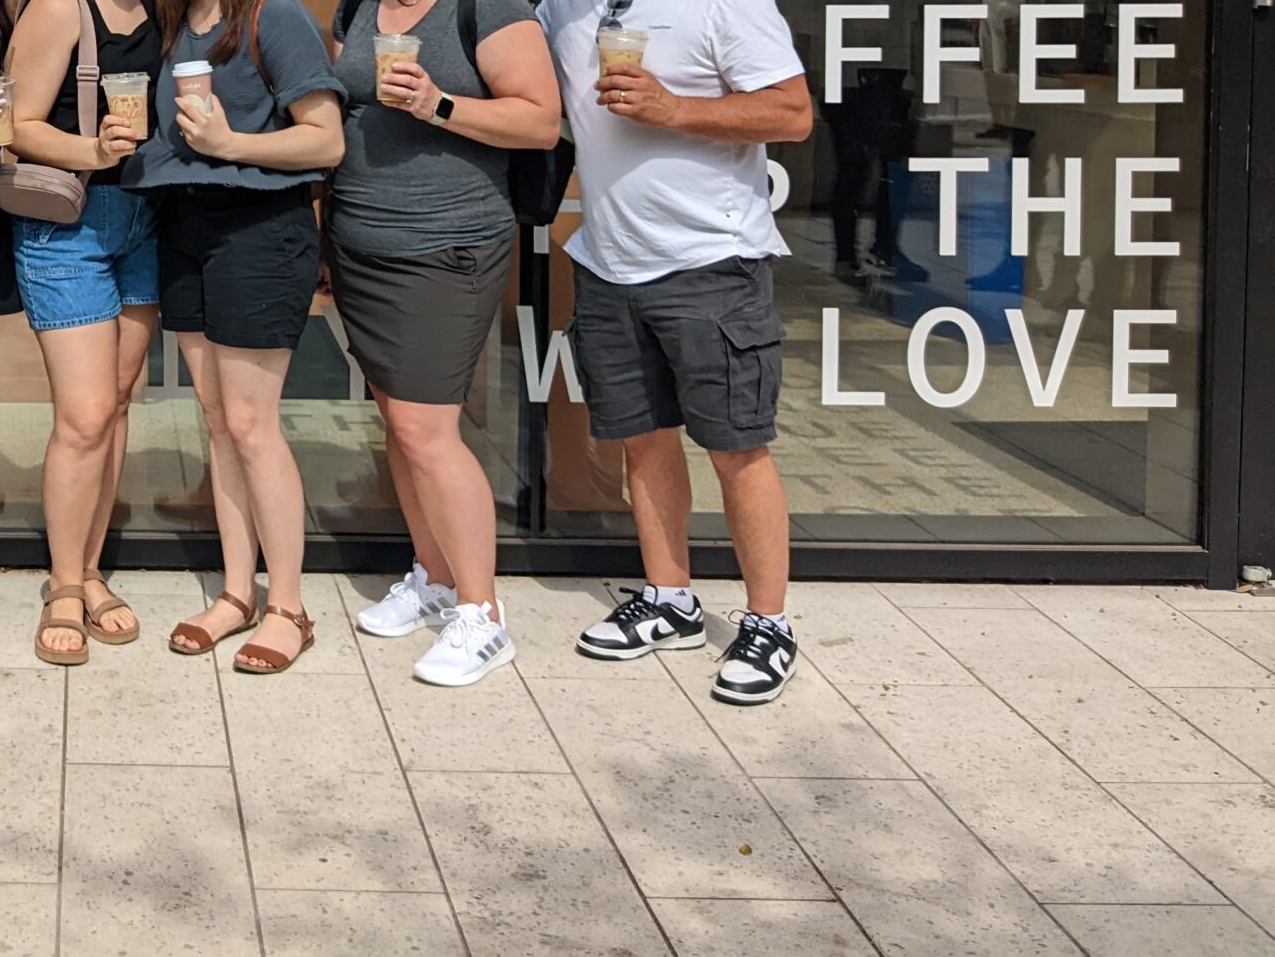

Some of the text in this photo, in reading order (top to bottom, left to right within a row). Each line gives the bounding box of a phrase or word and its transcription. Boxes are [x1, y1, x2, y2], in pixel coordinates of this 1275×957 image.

[824, 3, 1184, 104] FFEE
[908, 157, 1180, 257] THE
[821, 306, 1177, 409] LOVE
